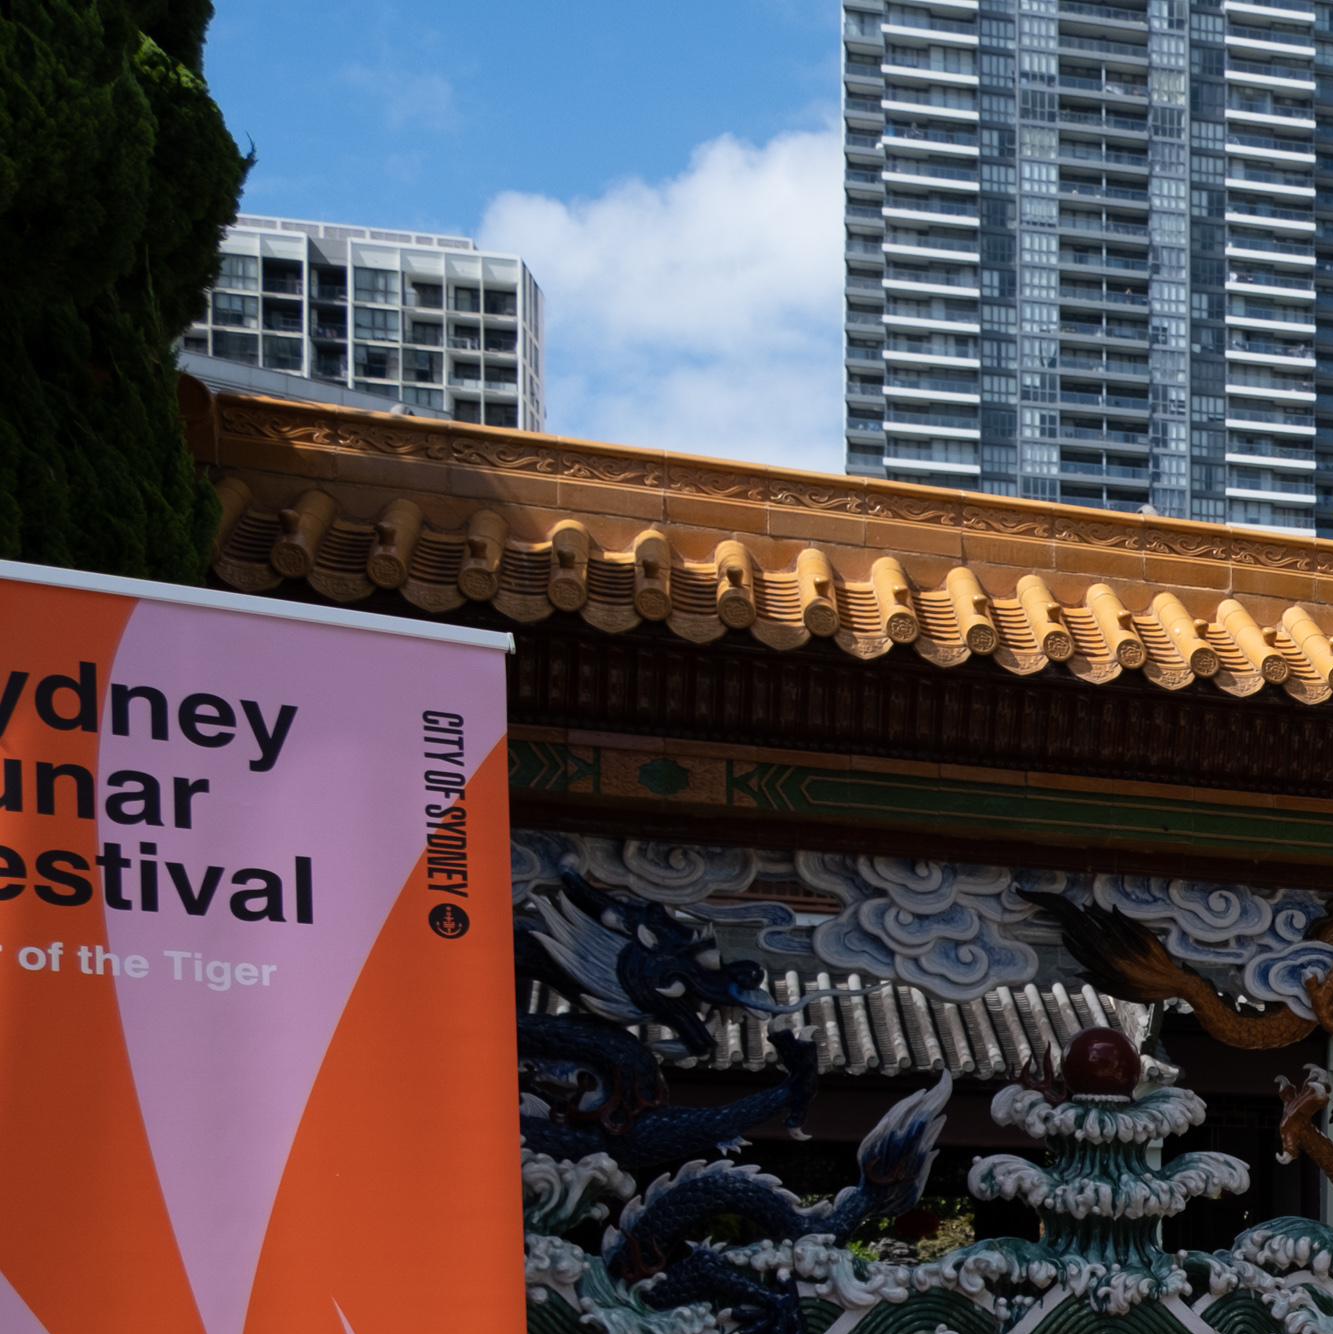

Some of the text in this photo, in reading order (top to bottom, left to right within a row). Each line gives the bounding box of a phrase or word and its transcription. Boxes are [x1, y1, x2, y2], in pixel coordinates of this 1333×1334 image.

[422, 710, 468, 898] CITY OF SYDNEY
[18, 942, 277, 992] of the Tiger
